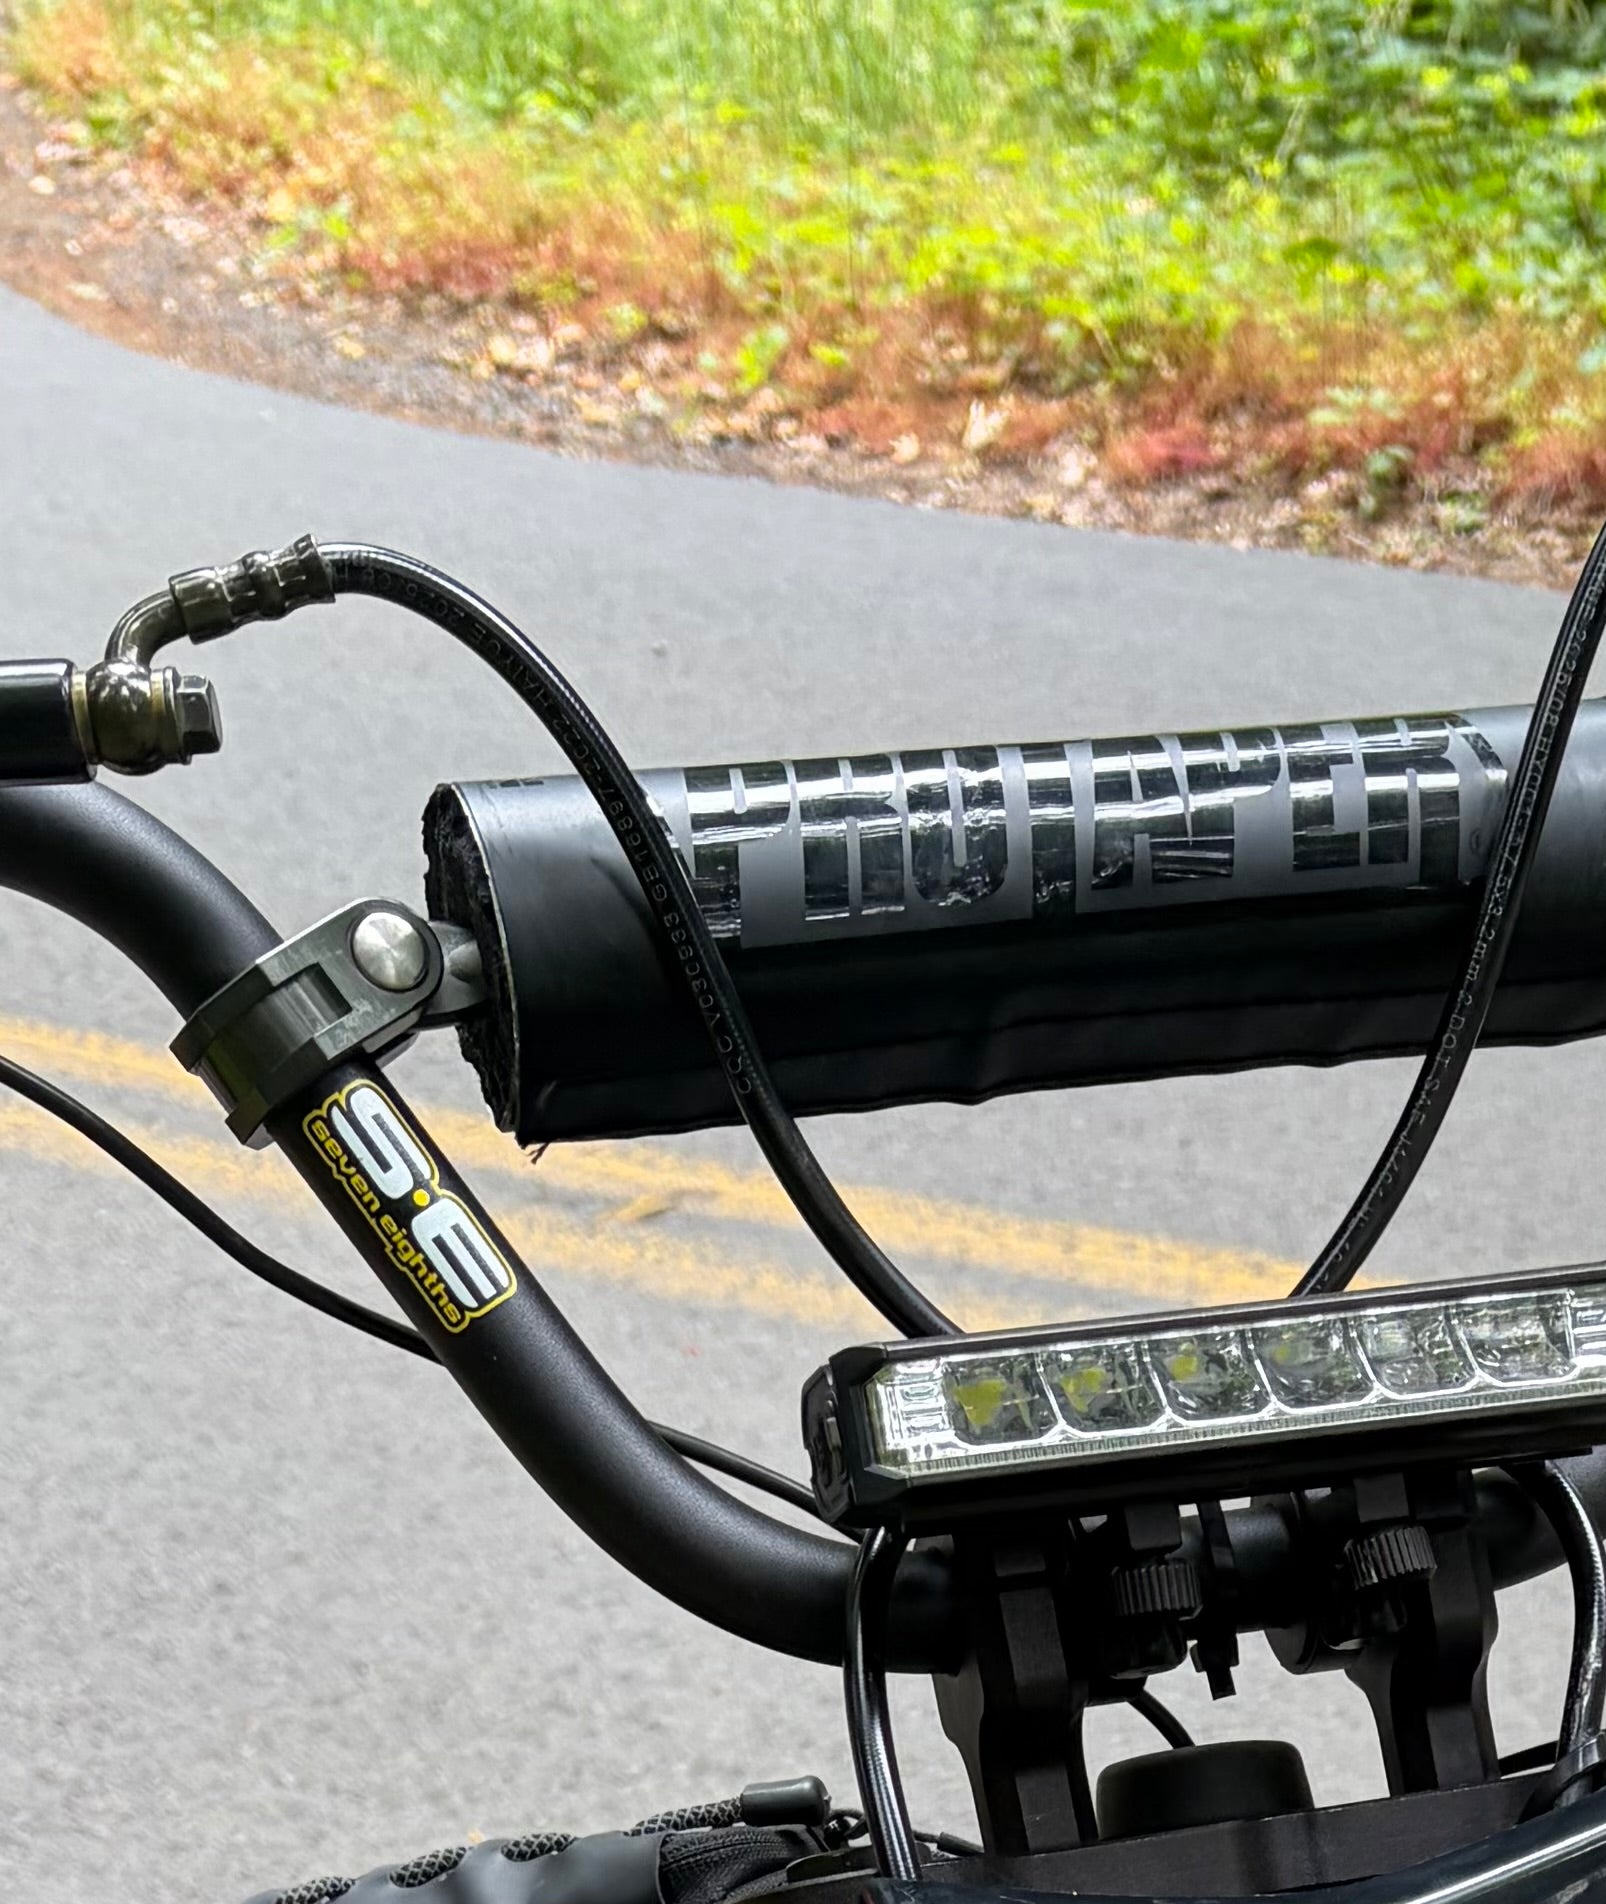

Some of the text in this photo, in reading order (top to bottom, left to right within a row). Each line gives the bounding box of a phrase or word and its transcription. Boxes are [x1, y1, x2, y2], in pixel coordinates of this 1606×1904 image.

[1435, 1013, 1465, 1067] DOT
[311, 1119, 461, 1324] seven eighths
